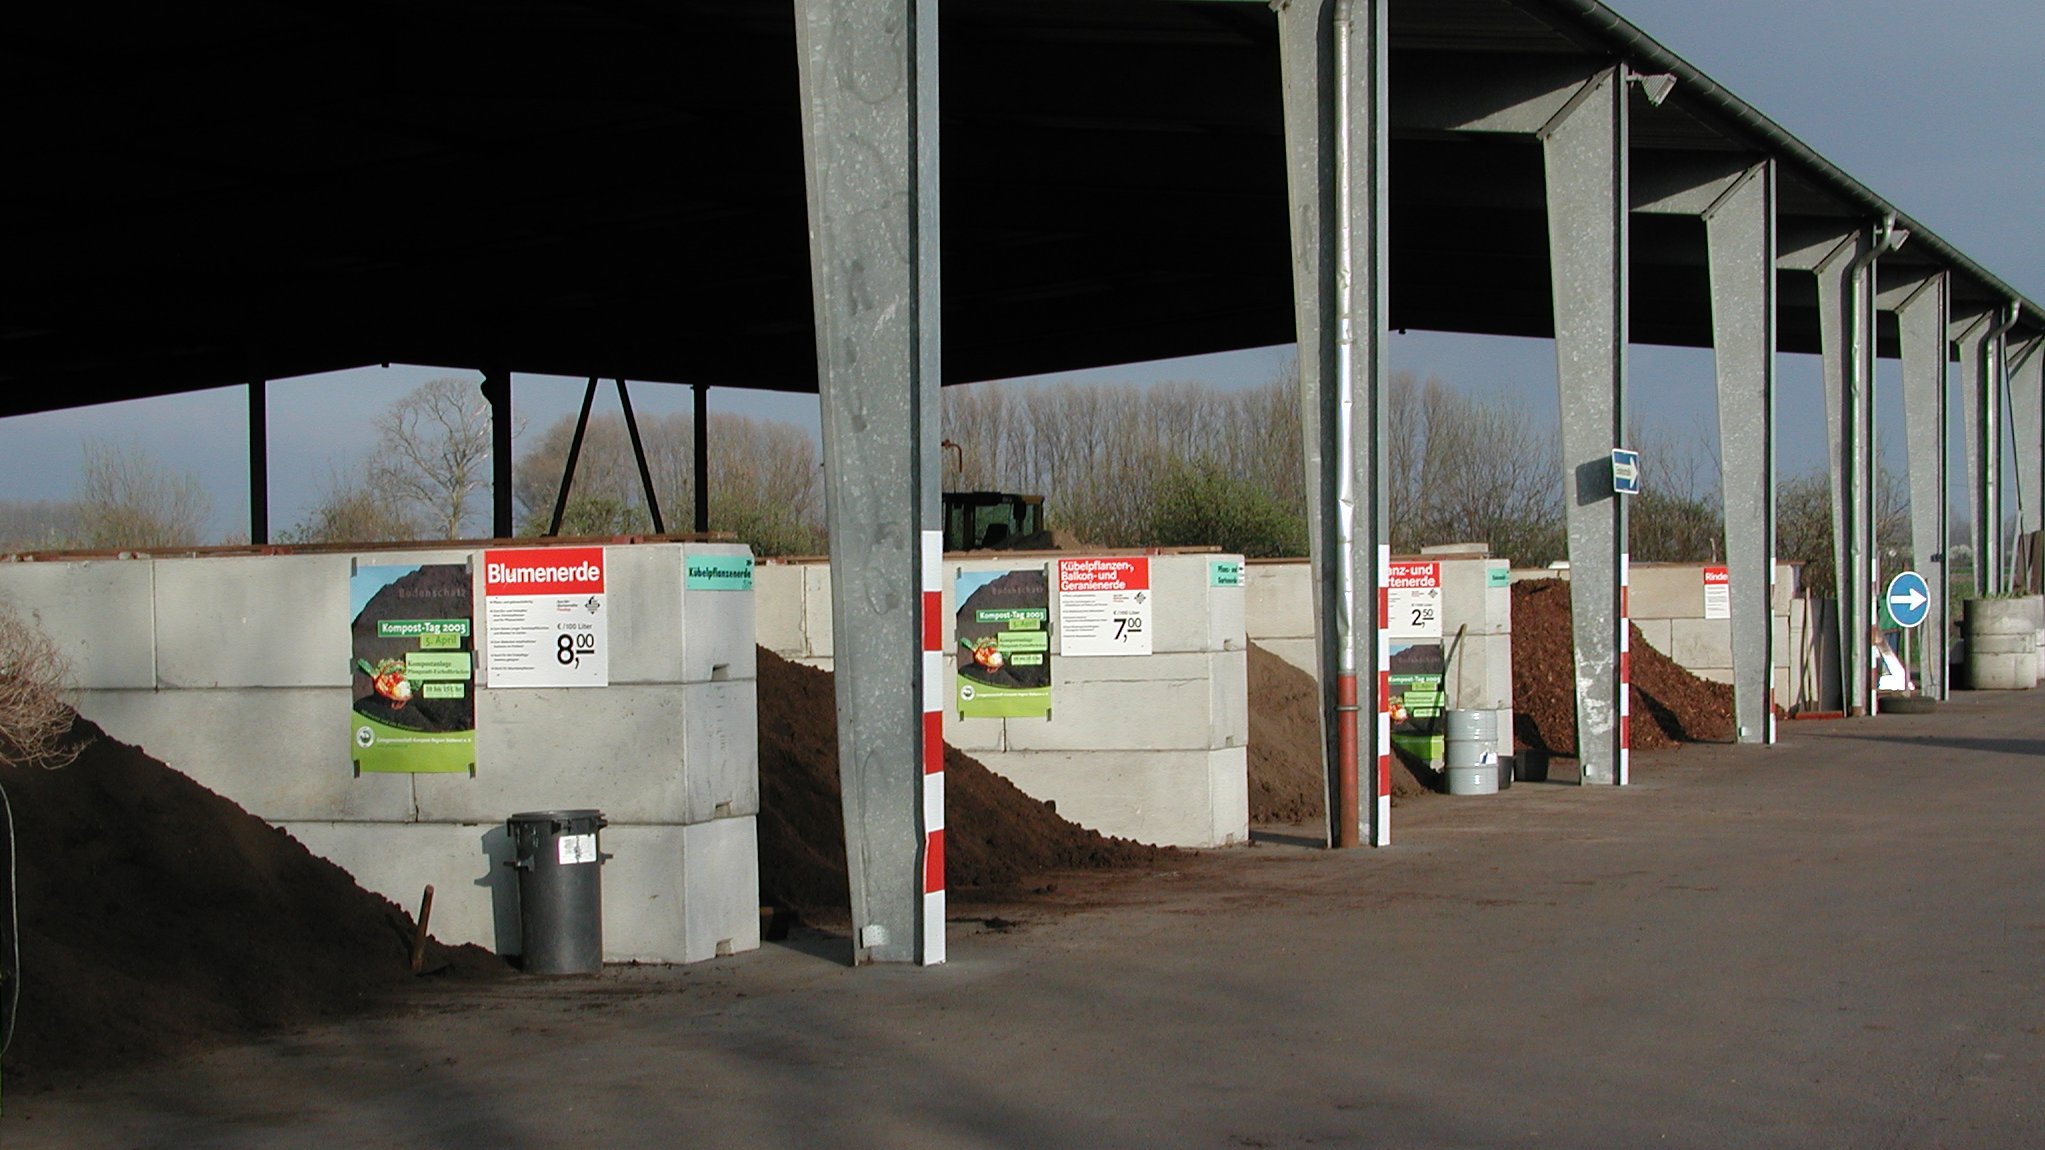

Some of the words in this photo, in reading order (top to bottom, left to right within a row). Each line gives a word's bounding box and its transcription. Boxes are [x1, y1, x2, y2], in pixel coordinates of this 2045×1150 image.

[487, 560, 600, 584] Blumenerde
[1061, 580, 1126, 590] Geranienerde
[382, 622, 441, 635] Kompost-Tag
[443, 623, 466, 634] 2003
[435, 634, 458, 647] April
